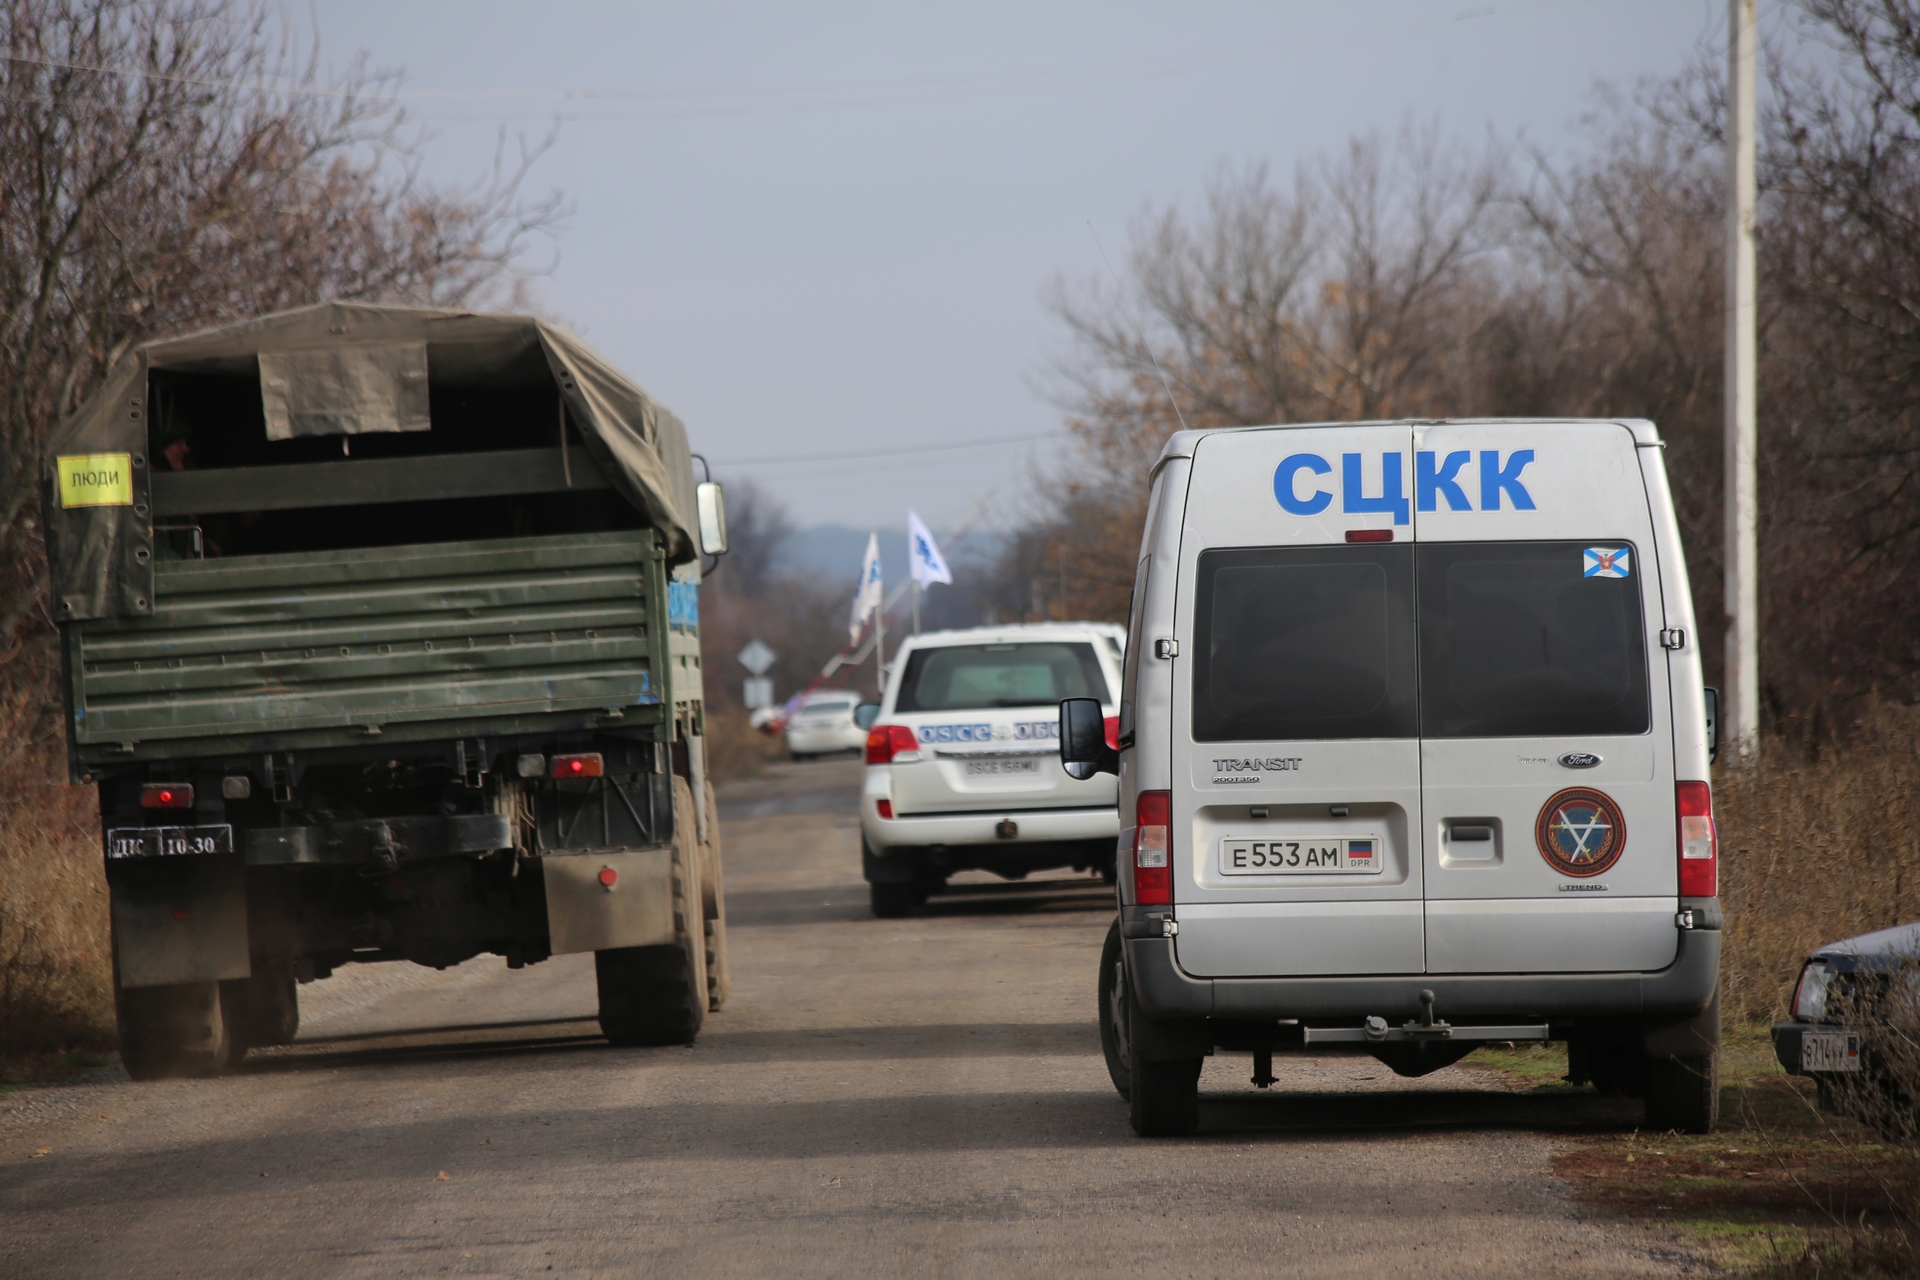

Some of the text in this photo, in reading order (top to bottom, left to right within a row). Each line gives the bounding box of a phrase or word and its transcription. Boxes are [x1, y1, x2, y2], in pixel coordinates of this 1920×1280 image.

[72, 471, 119, 488] ЛЮДИ
[1273, 449, 1537, 525] СЦКК
[1212, 758, 1302, 771] TRANSIT
[1567, 753, 1594, 765] Ford
[1350, 859, 1370, 867] DPR
